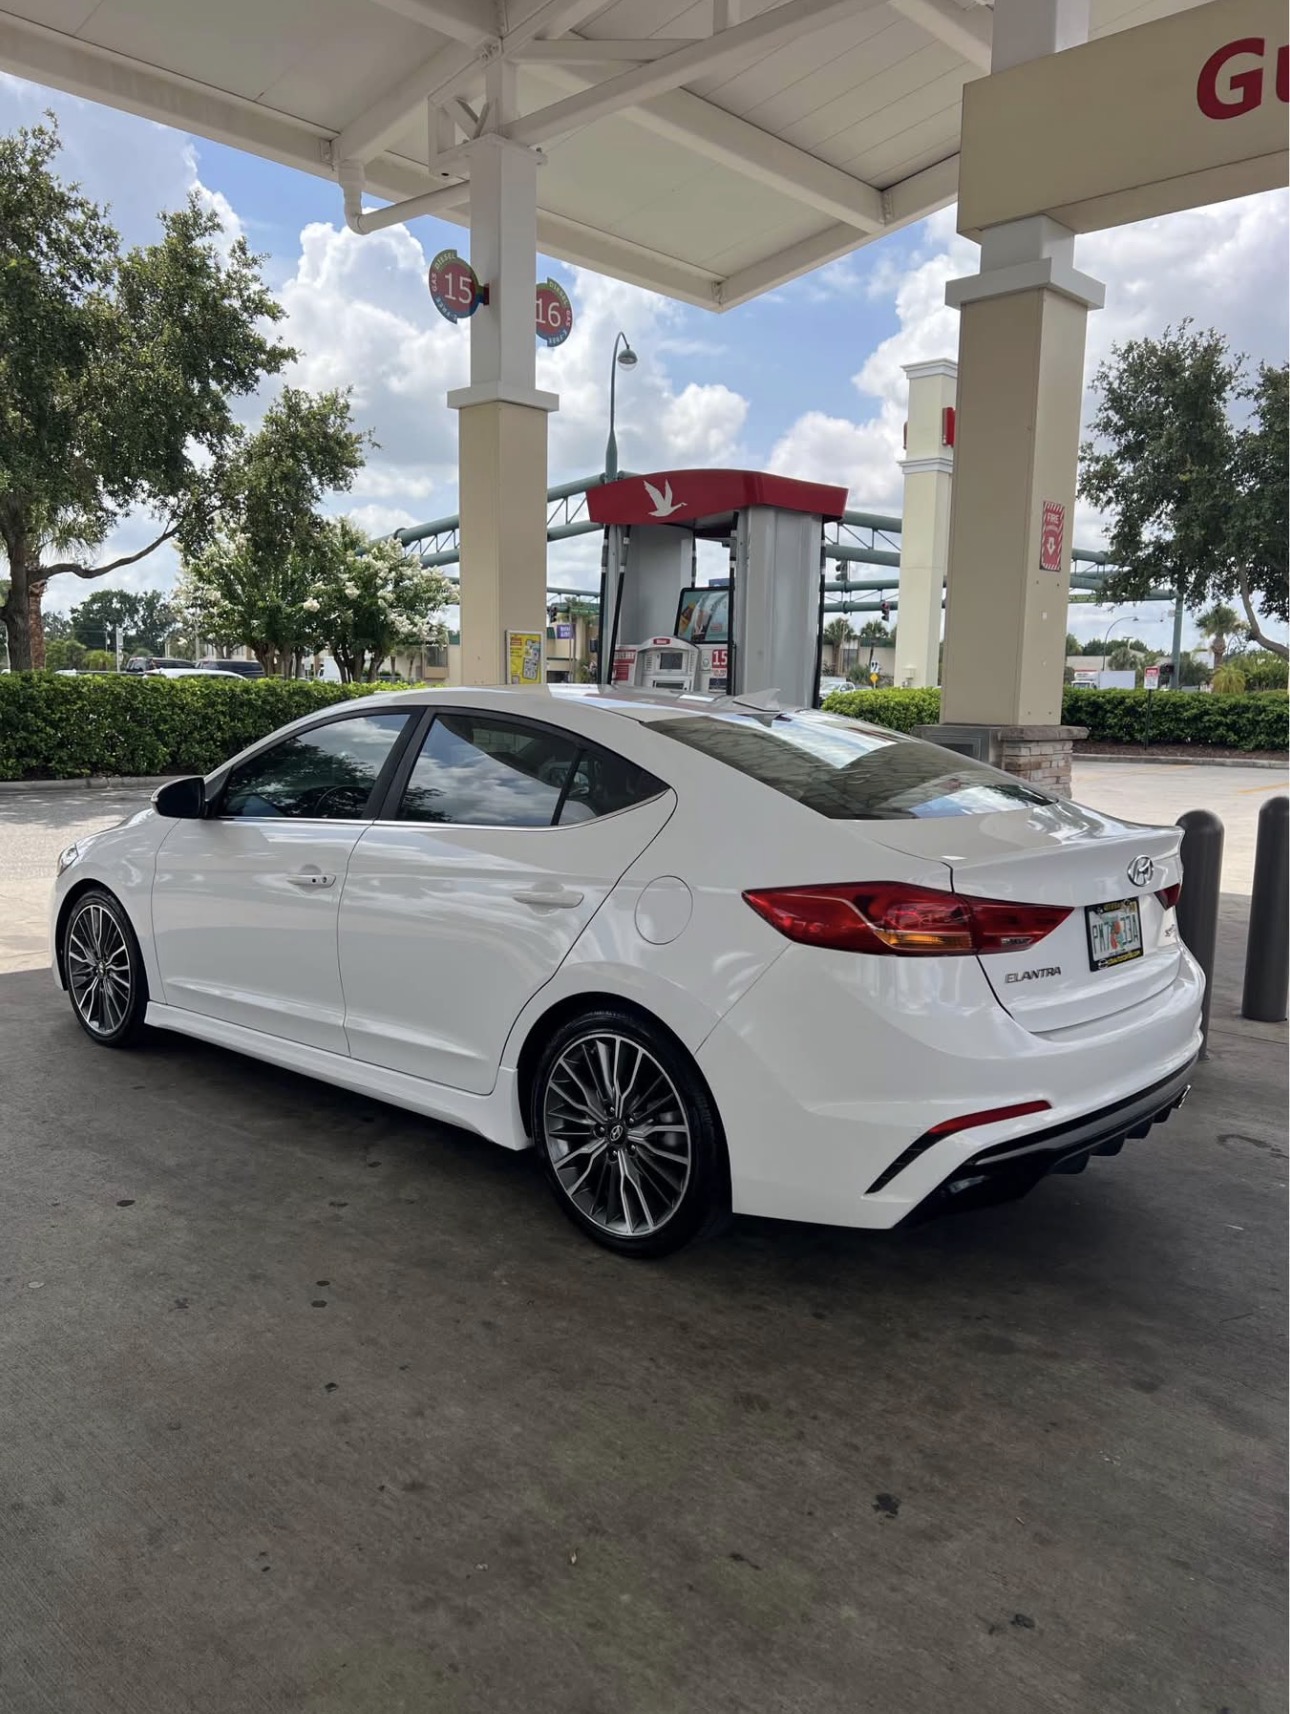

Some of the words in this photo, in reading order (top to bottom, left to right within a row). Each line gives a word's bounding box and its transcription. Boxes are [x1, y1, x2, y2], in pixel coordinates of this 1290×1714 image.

[434, 252, 456, 270] DIESEL
[444, 272, 472, 304] 15
[536, 298, 561, 327] 16
[1046, 512, 1060, 524] FIRE
[713, 651, 728, 665] 15
[1005, 966, 1061, 983] ELANTRA
